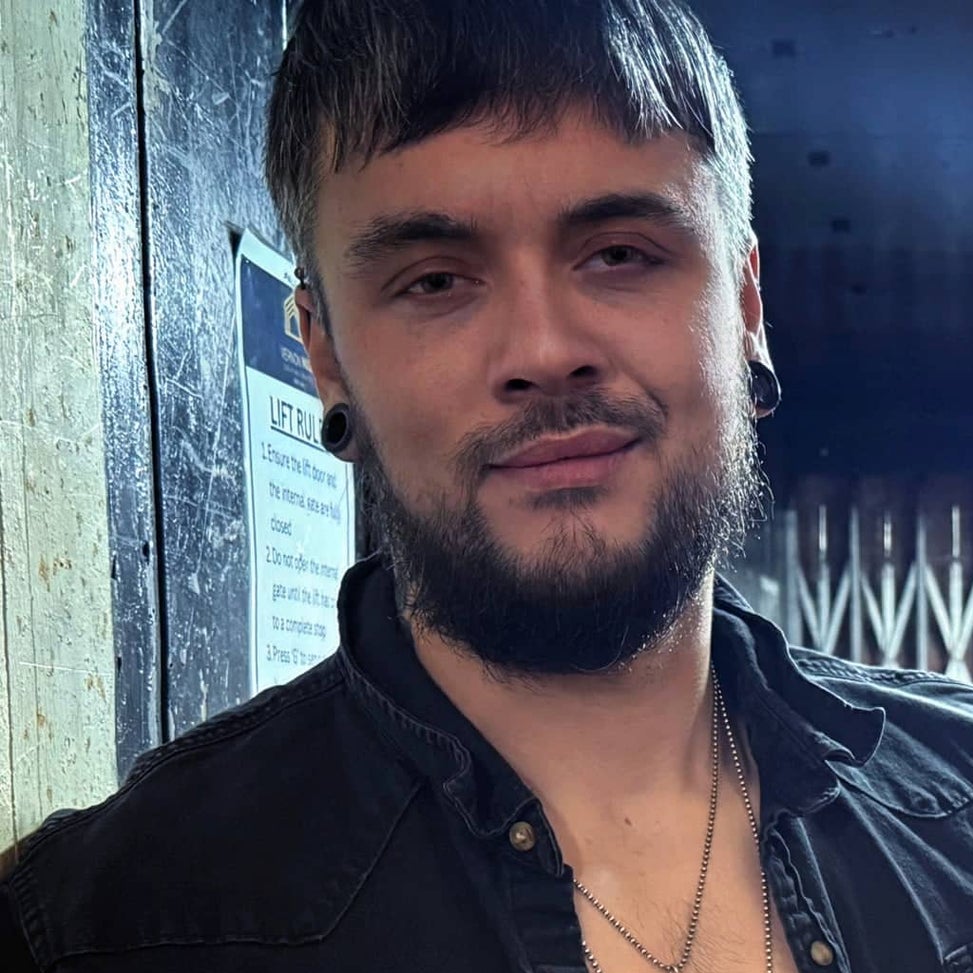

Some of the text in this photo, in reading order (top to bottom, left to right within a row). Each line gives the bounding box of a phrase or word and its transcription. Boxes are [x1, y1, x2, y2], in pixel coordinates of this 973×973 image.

[270, 395, 322, 443] LIFT RUL
[269, 482, 280, 500] the
